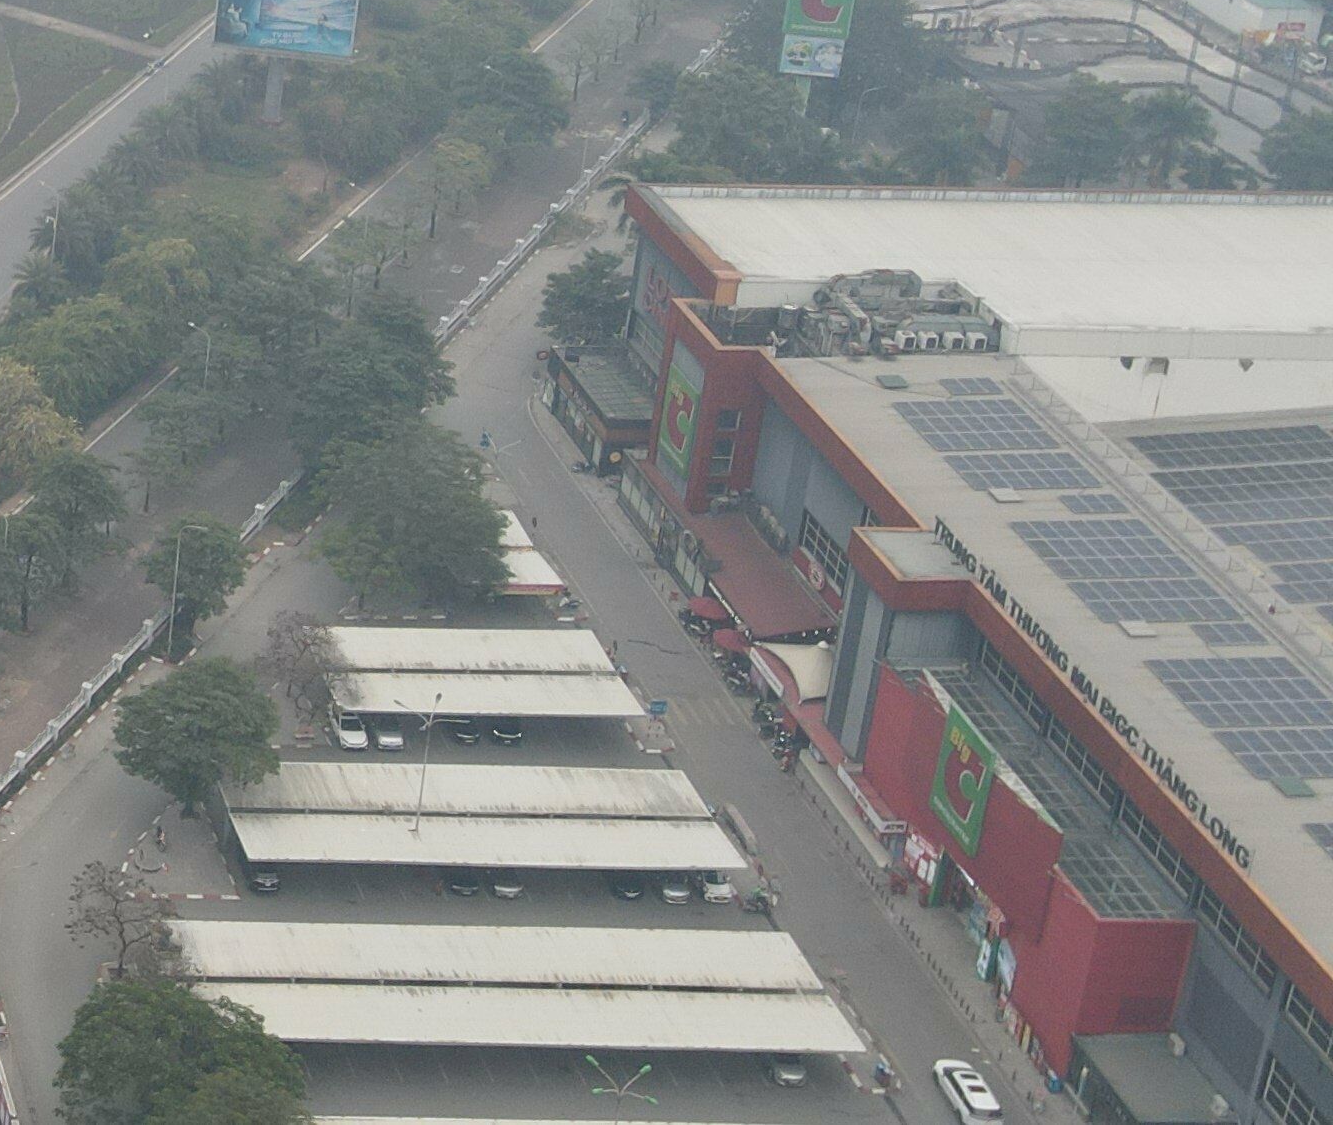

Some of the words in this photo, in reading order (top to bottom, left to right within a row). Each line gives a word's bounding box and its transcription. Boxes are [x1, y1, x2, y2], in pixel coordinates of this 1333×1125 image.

[666, 391, 695, 454] C
[934, 515, 977, 573] TRUNG
[1199, 803, 1250, 869] LONG
[950, 726, 972, 764] Big
[944, 747, 988, 824] C
